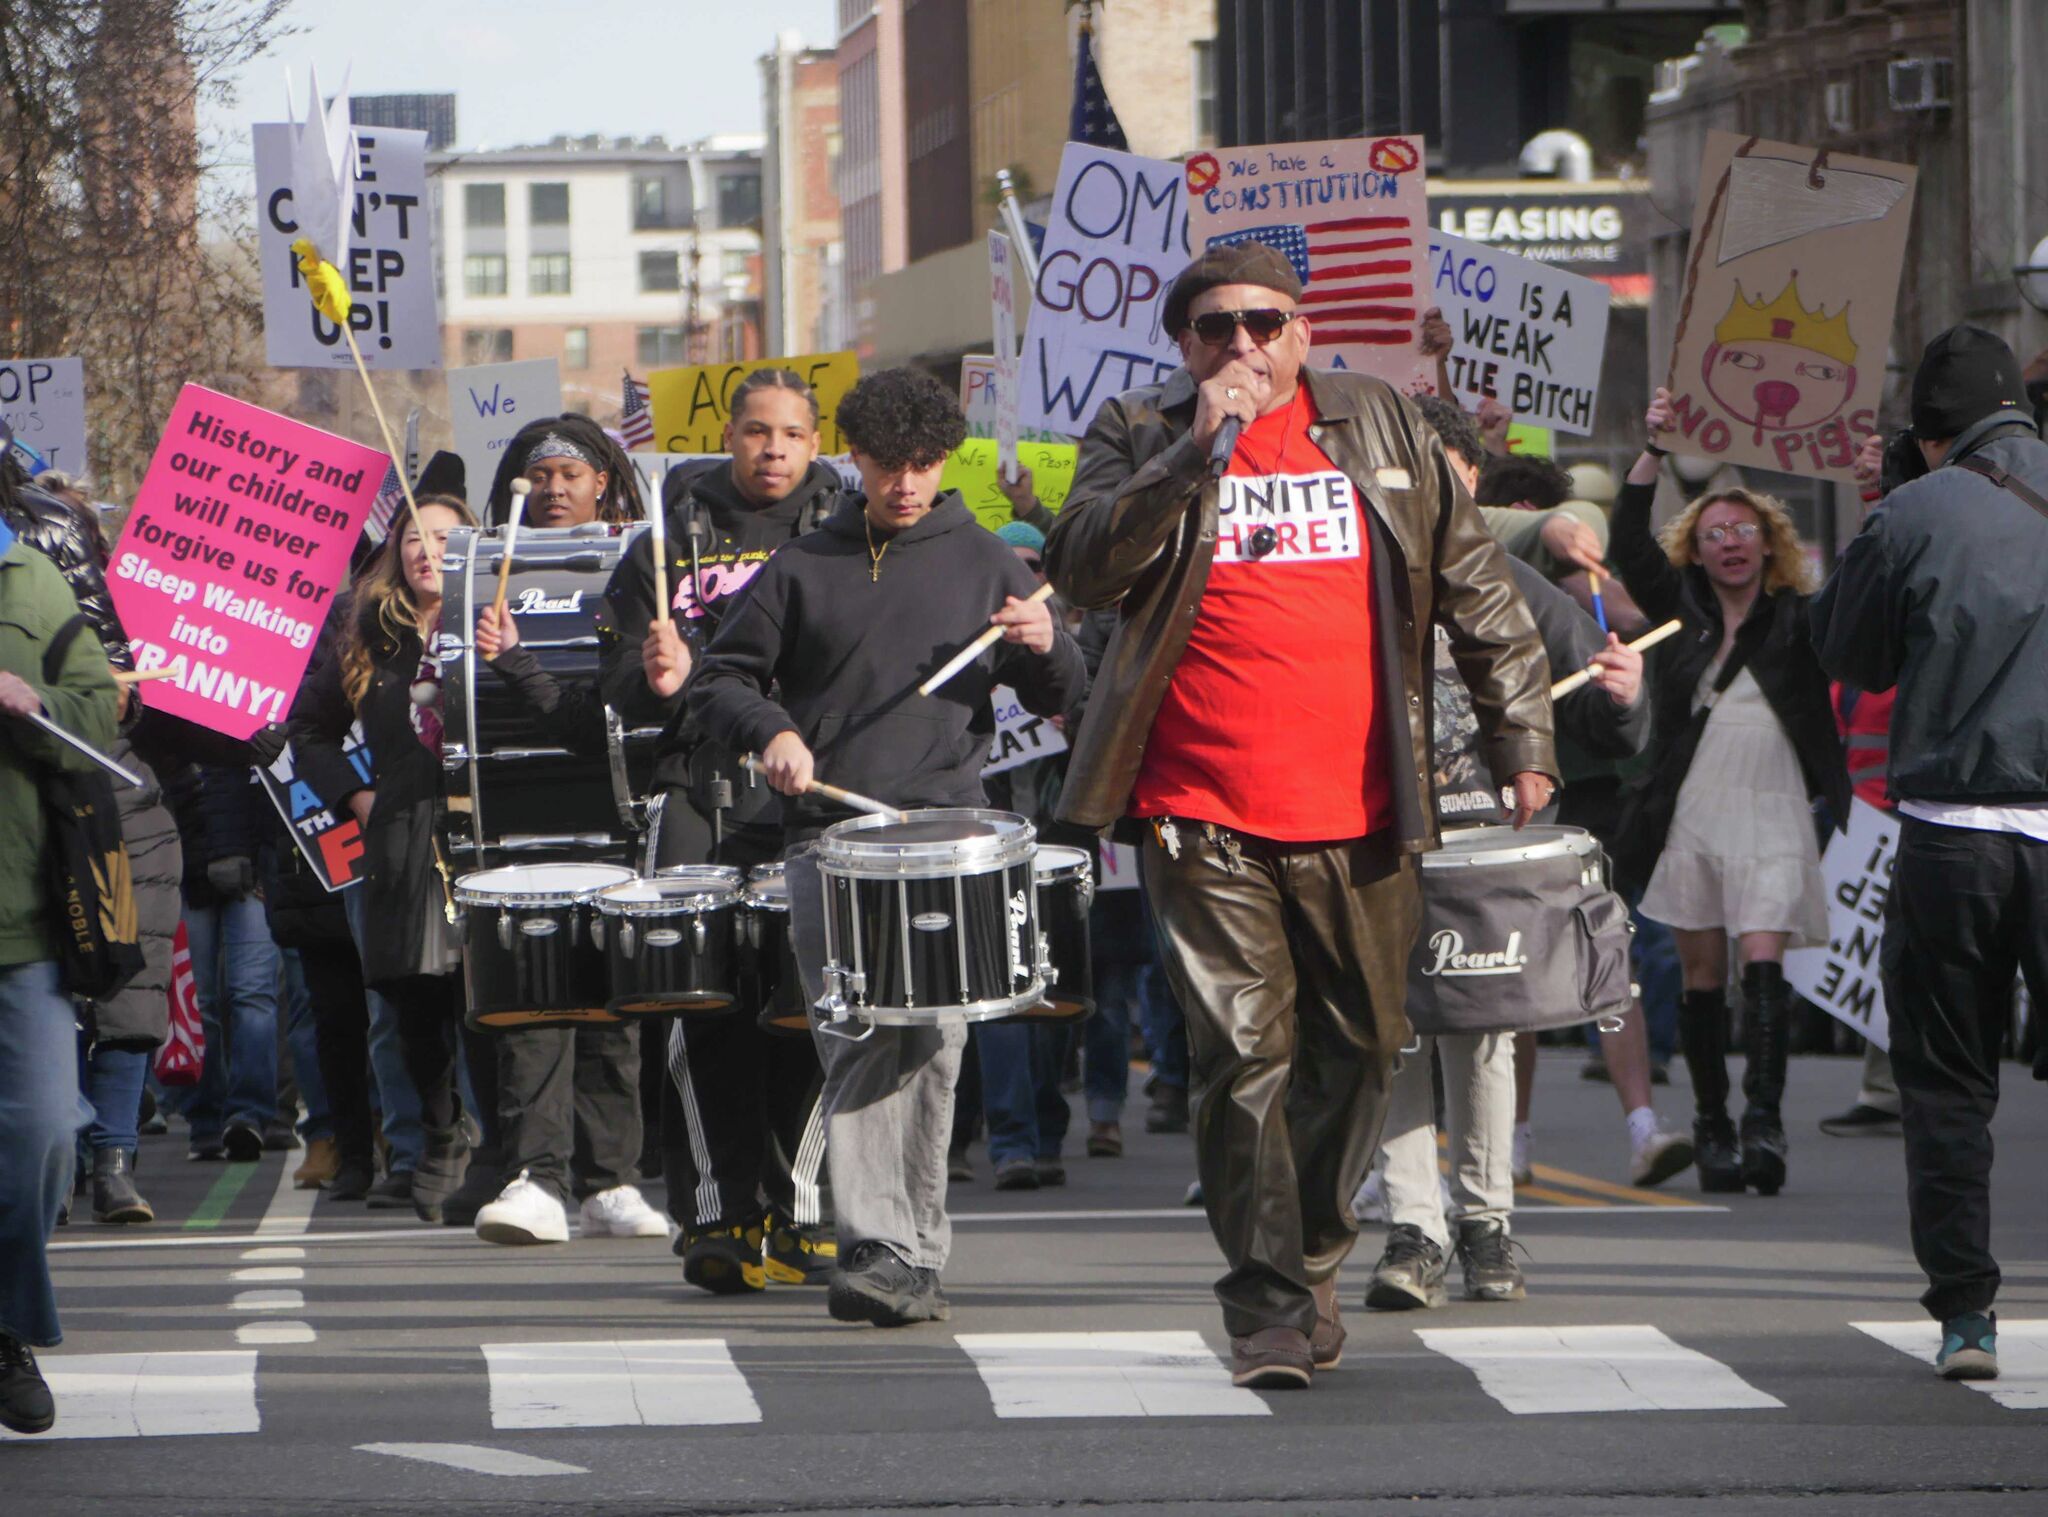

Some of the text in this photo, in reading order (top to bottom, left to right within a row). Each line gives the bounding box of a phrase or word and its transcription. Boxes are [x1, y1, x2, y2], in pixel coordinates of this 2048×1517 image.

[354, 137, 377, 182] E
[1228, 152, 1335, 177] We have a
[268, 187, 419, 240] CN'T
[1065, 160, 1191, 253] OM
[1204, 170, 1398, 214] CONSTITUTION
[1440, 206, 1622, 242] LEASING
[290, 247, 404, 293] EP
[1036, 250, 1160, 328] GOP
[1520, 283, 1572, 328] IS A
[1463, 308, 1554, 375] WEAK
[469, 384, 515, 417] We
[1451, 355, 1592, 428] TLE BITCH
[187, 411, 364, 493] History and
[1672, 393, 1732, 453] NO
[170, 452, 349, 530] our children
[1219, 477, 1348, 515] UNITE
[174, 493, 320, 559] will never
[132, 514, 330, 603] forgive us for
[115, 553, 314, 649] Sleep Walking
[510, 587, 583, 614] Pearl
[169, 615, 228, 656] into
[129, 639, 286, 722] RANNY!
[1814, 961, 1876, 1025] WE
